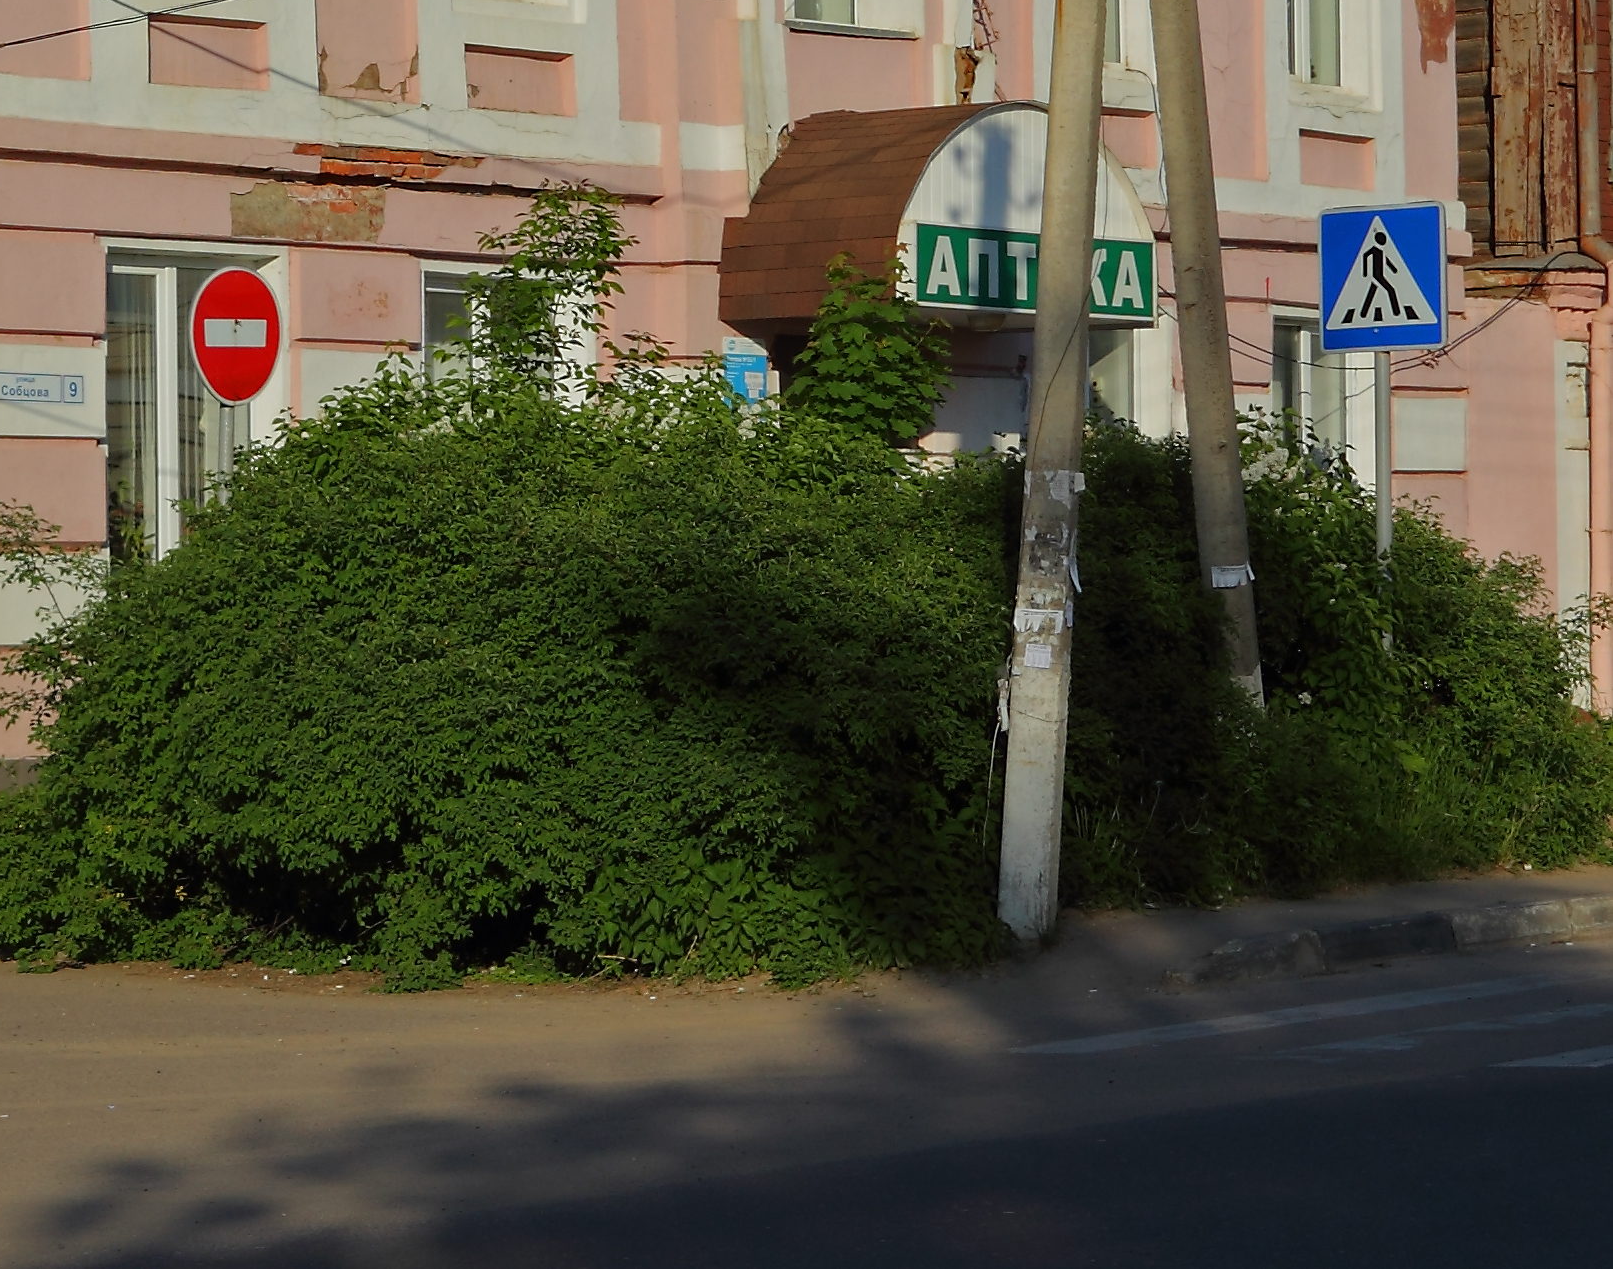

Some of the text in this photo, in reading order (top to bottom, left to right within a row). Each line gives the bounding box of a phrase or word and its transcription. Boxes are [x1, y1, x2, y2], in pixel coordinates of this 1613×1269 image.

[926, 235, 1144, 309] АПТКА
[1, 385, 49, 398] Собцова
[69, 382, 77, 397] 9
